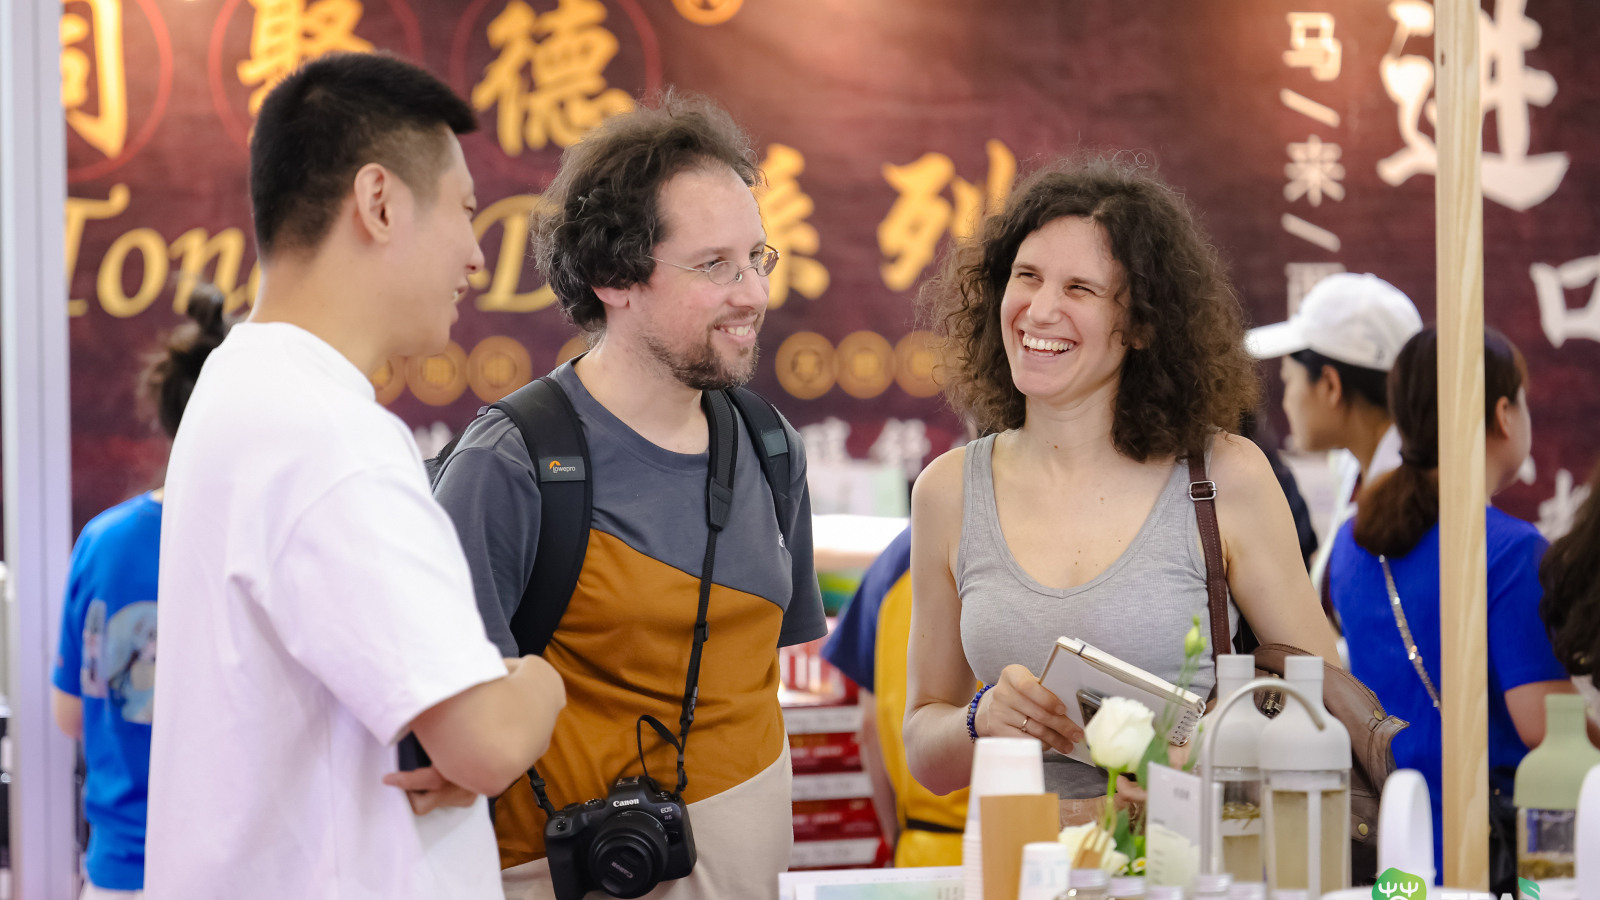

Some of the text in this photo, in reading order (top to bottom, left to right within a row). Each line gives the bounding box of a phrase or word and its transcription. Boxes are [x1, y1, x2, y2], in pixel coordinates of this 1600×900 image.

[62, 182, 264, 319] Ton
[613, 798, 640, 808] Canon
[611, 861, 634, 878] Canon
